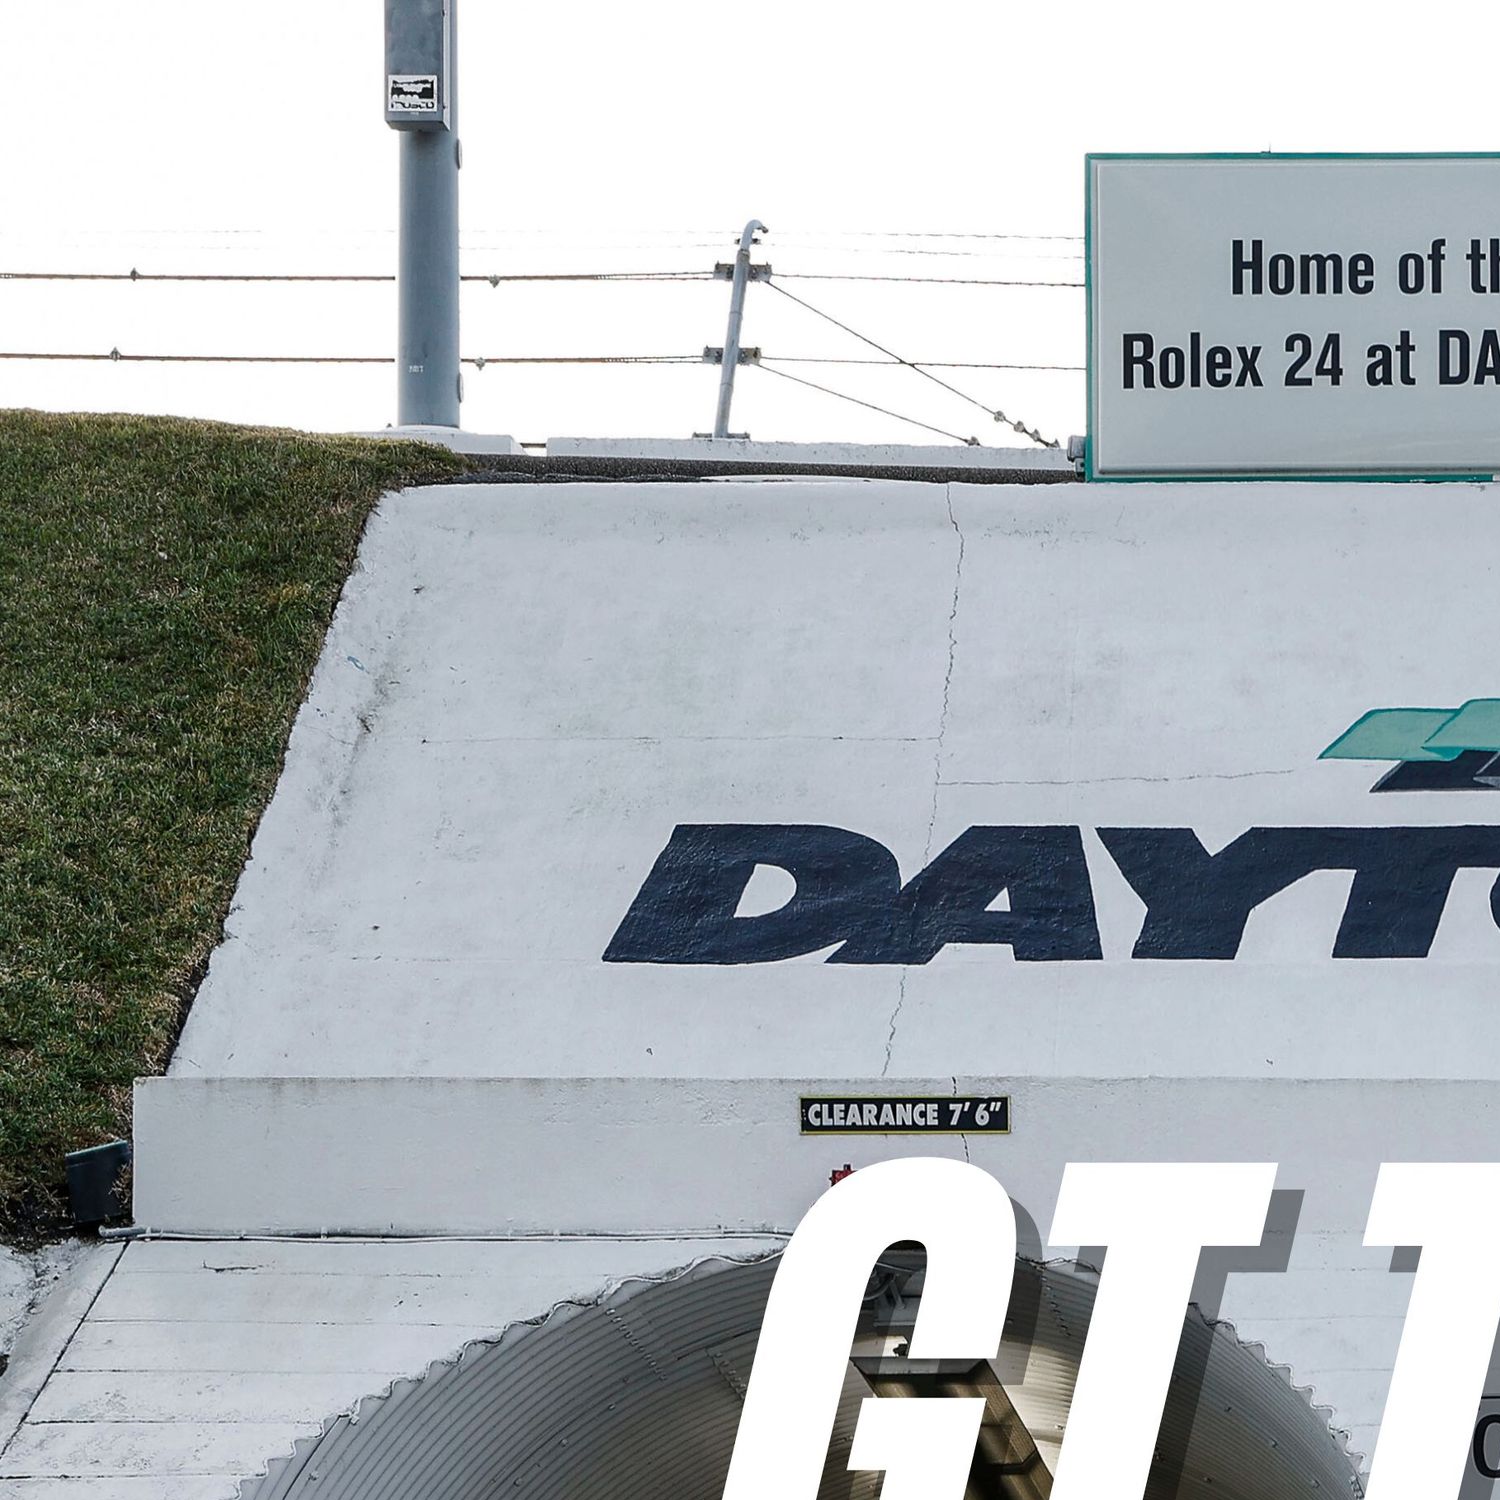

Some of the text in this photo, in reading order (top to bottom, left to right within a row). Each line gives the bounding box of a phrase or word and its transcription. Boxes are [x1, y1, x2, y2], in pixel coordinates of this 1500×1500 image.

[1232, 239, 1375, 296] Home
[1398, 238, 1447, 295] of
[1122, 331, 1264, 390] Rolex
[1284, 333, 1344, 388] 24
[1366, 330, 1416, 388] at
[807, 1103, 939, 1126] CLEARANCE
